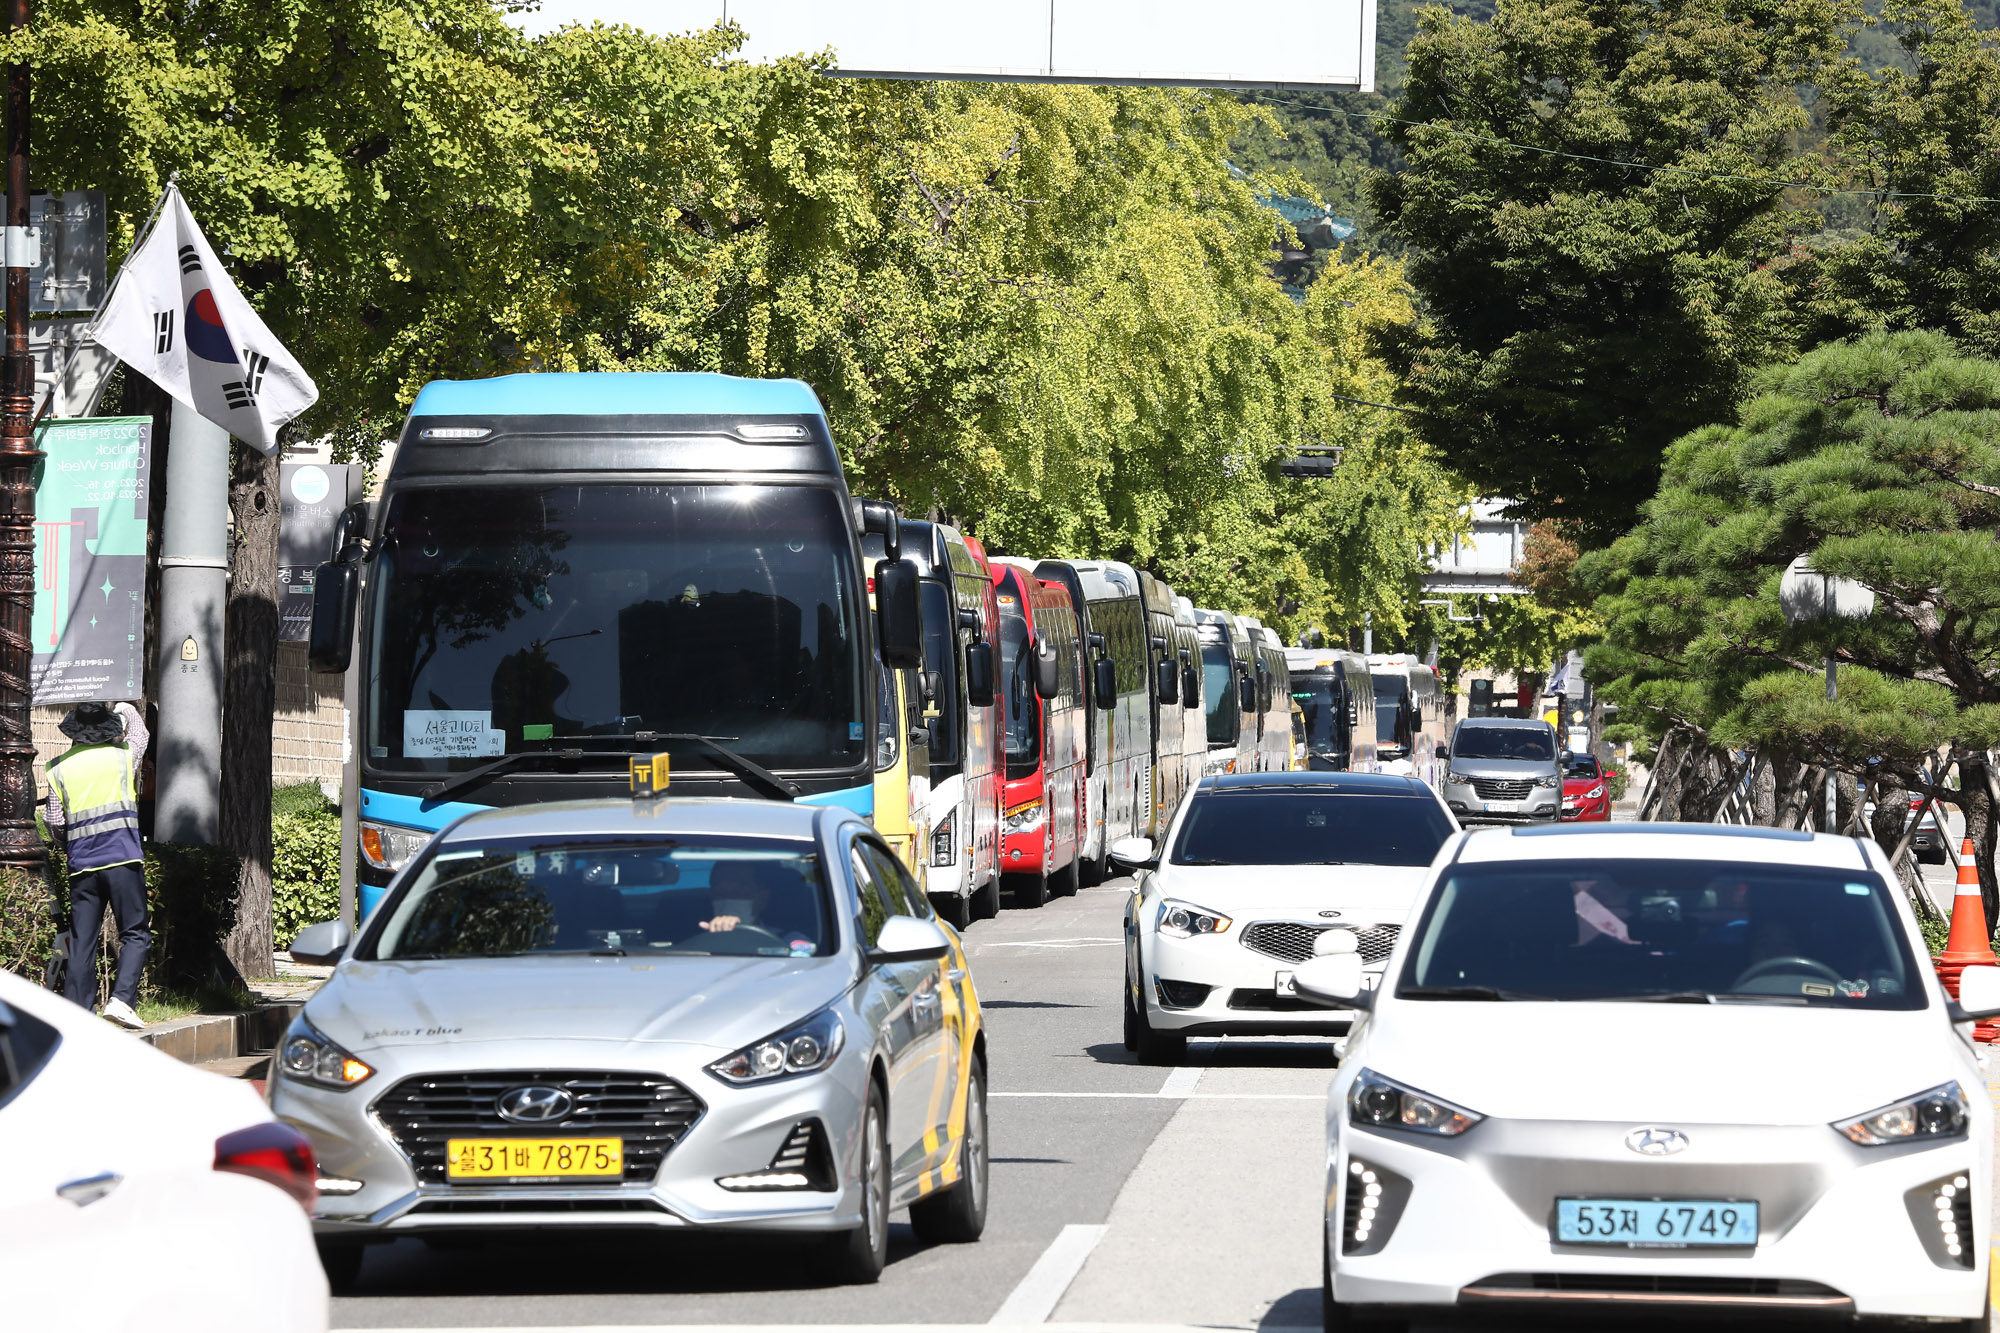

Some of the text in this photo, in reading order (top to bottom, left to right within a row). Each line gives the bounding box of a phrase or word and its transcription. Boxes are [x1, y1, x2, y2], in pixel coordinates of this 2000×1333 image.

[285, 504, 333, 519] 마을버스
[538, 1144, 610, 1170] 7875
[1576, 1206, 1738, 1238] 53저 6749
